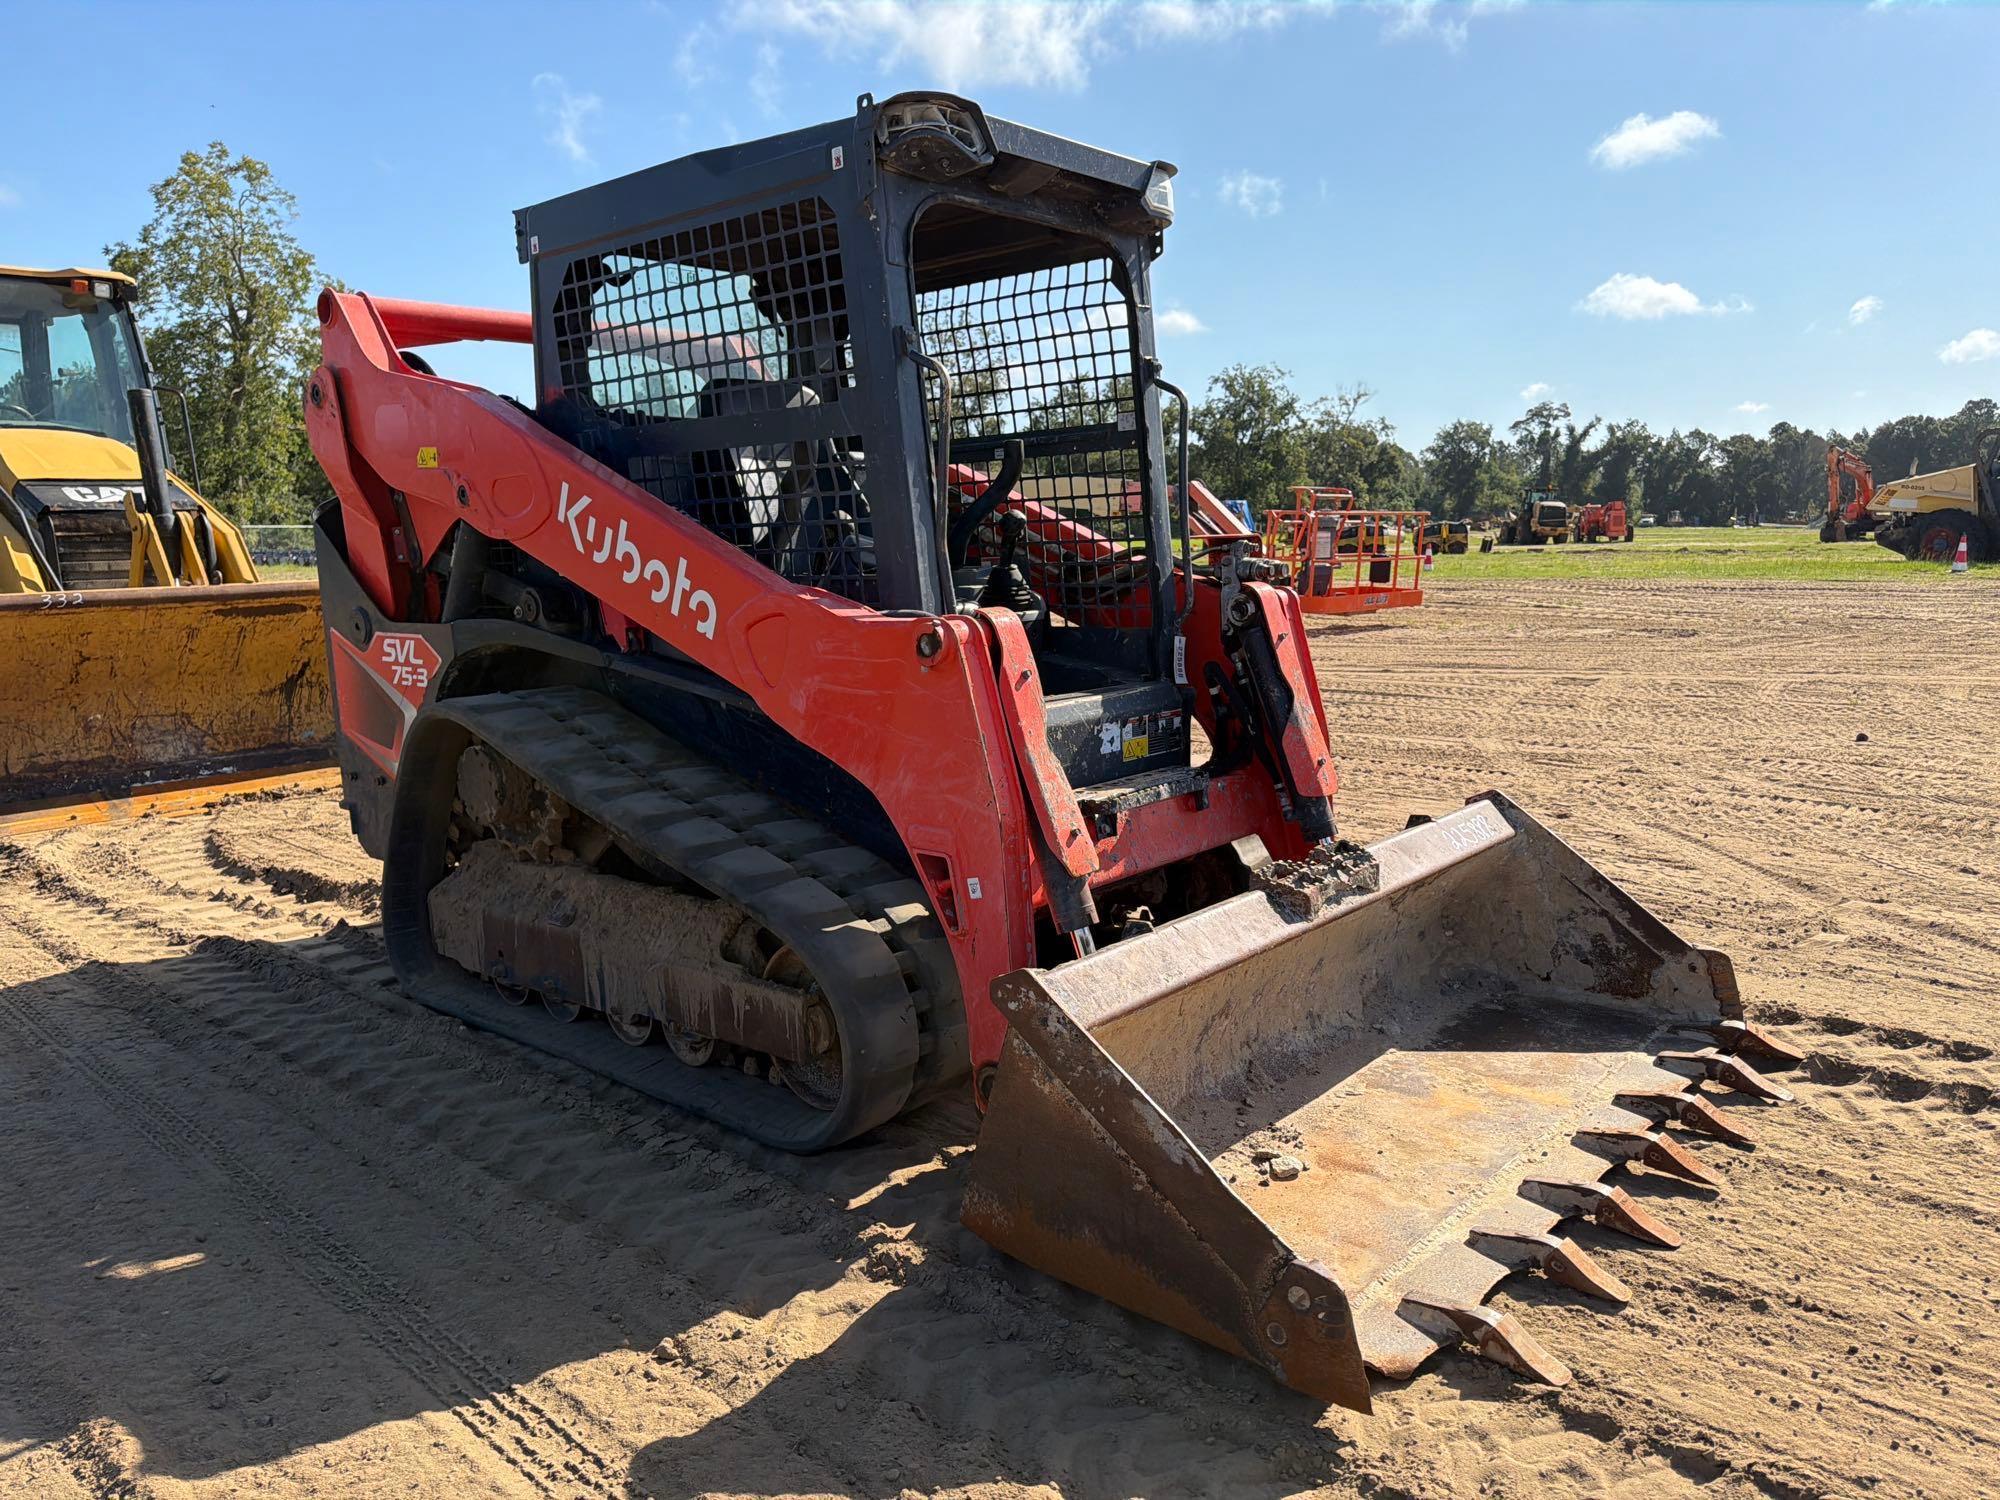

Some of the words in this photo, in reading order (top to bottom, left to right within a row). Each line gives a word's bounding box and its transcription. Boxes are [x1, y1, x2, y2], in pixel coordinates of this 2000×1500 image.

[558, 481, 717, 640] Kubota
[40, 593, 84, 610] 332
[382, 638, 423, 665] SVL
[392, 665, 428, 688] 75-3
